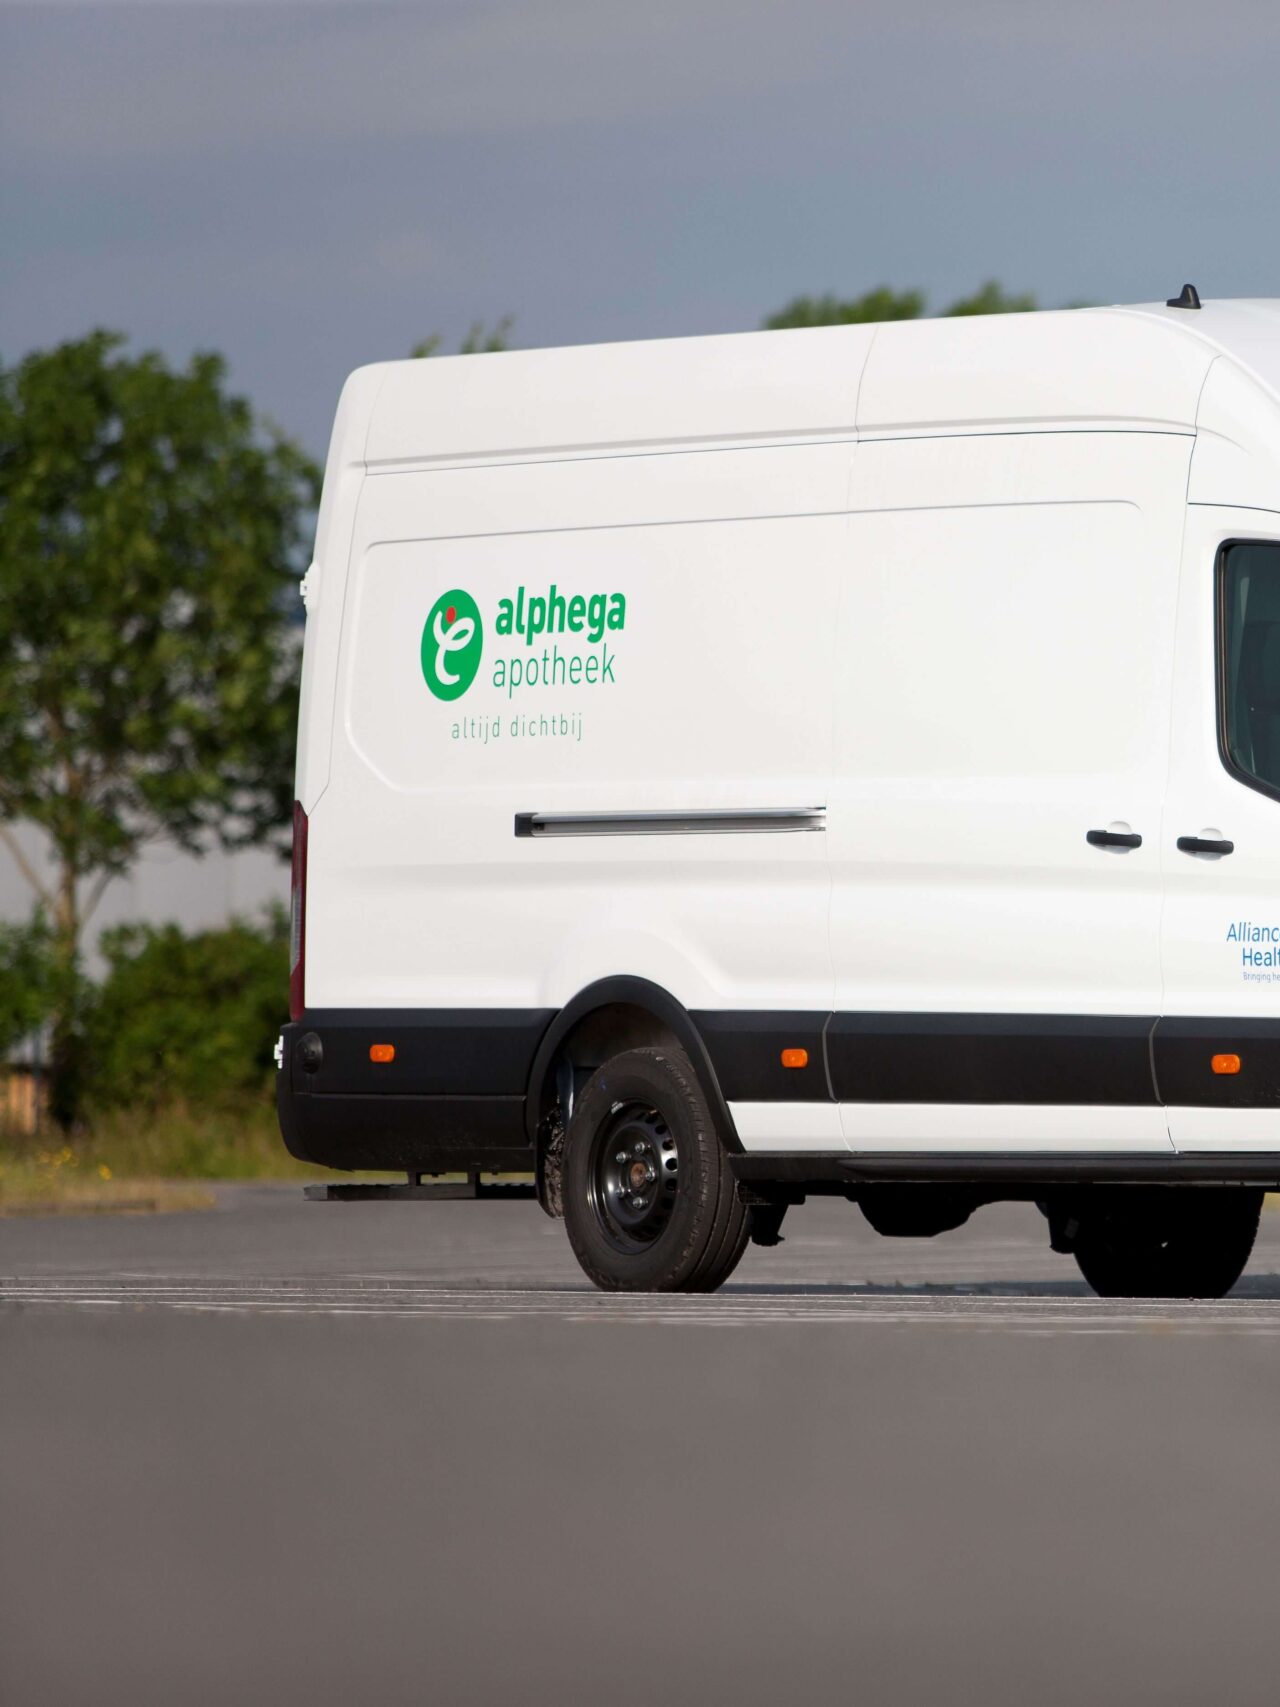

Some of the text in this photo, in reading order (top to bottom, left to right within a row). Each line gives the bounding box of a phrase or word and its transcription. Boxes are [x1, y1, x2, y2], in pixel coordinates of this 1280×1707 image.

[495, 584, 627, 646] alphega
[492, 642, 616, 700] apotheek
[451, 712, 583, 745] altijd dichtbij
[1243, 971, 1271, 983] Bringing
